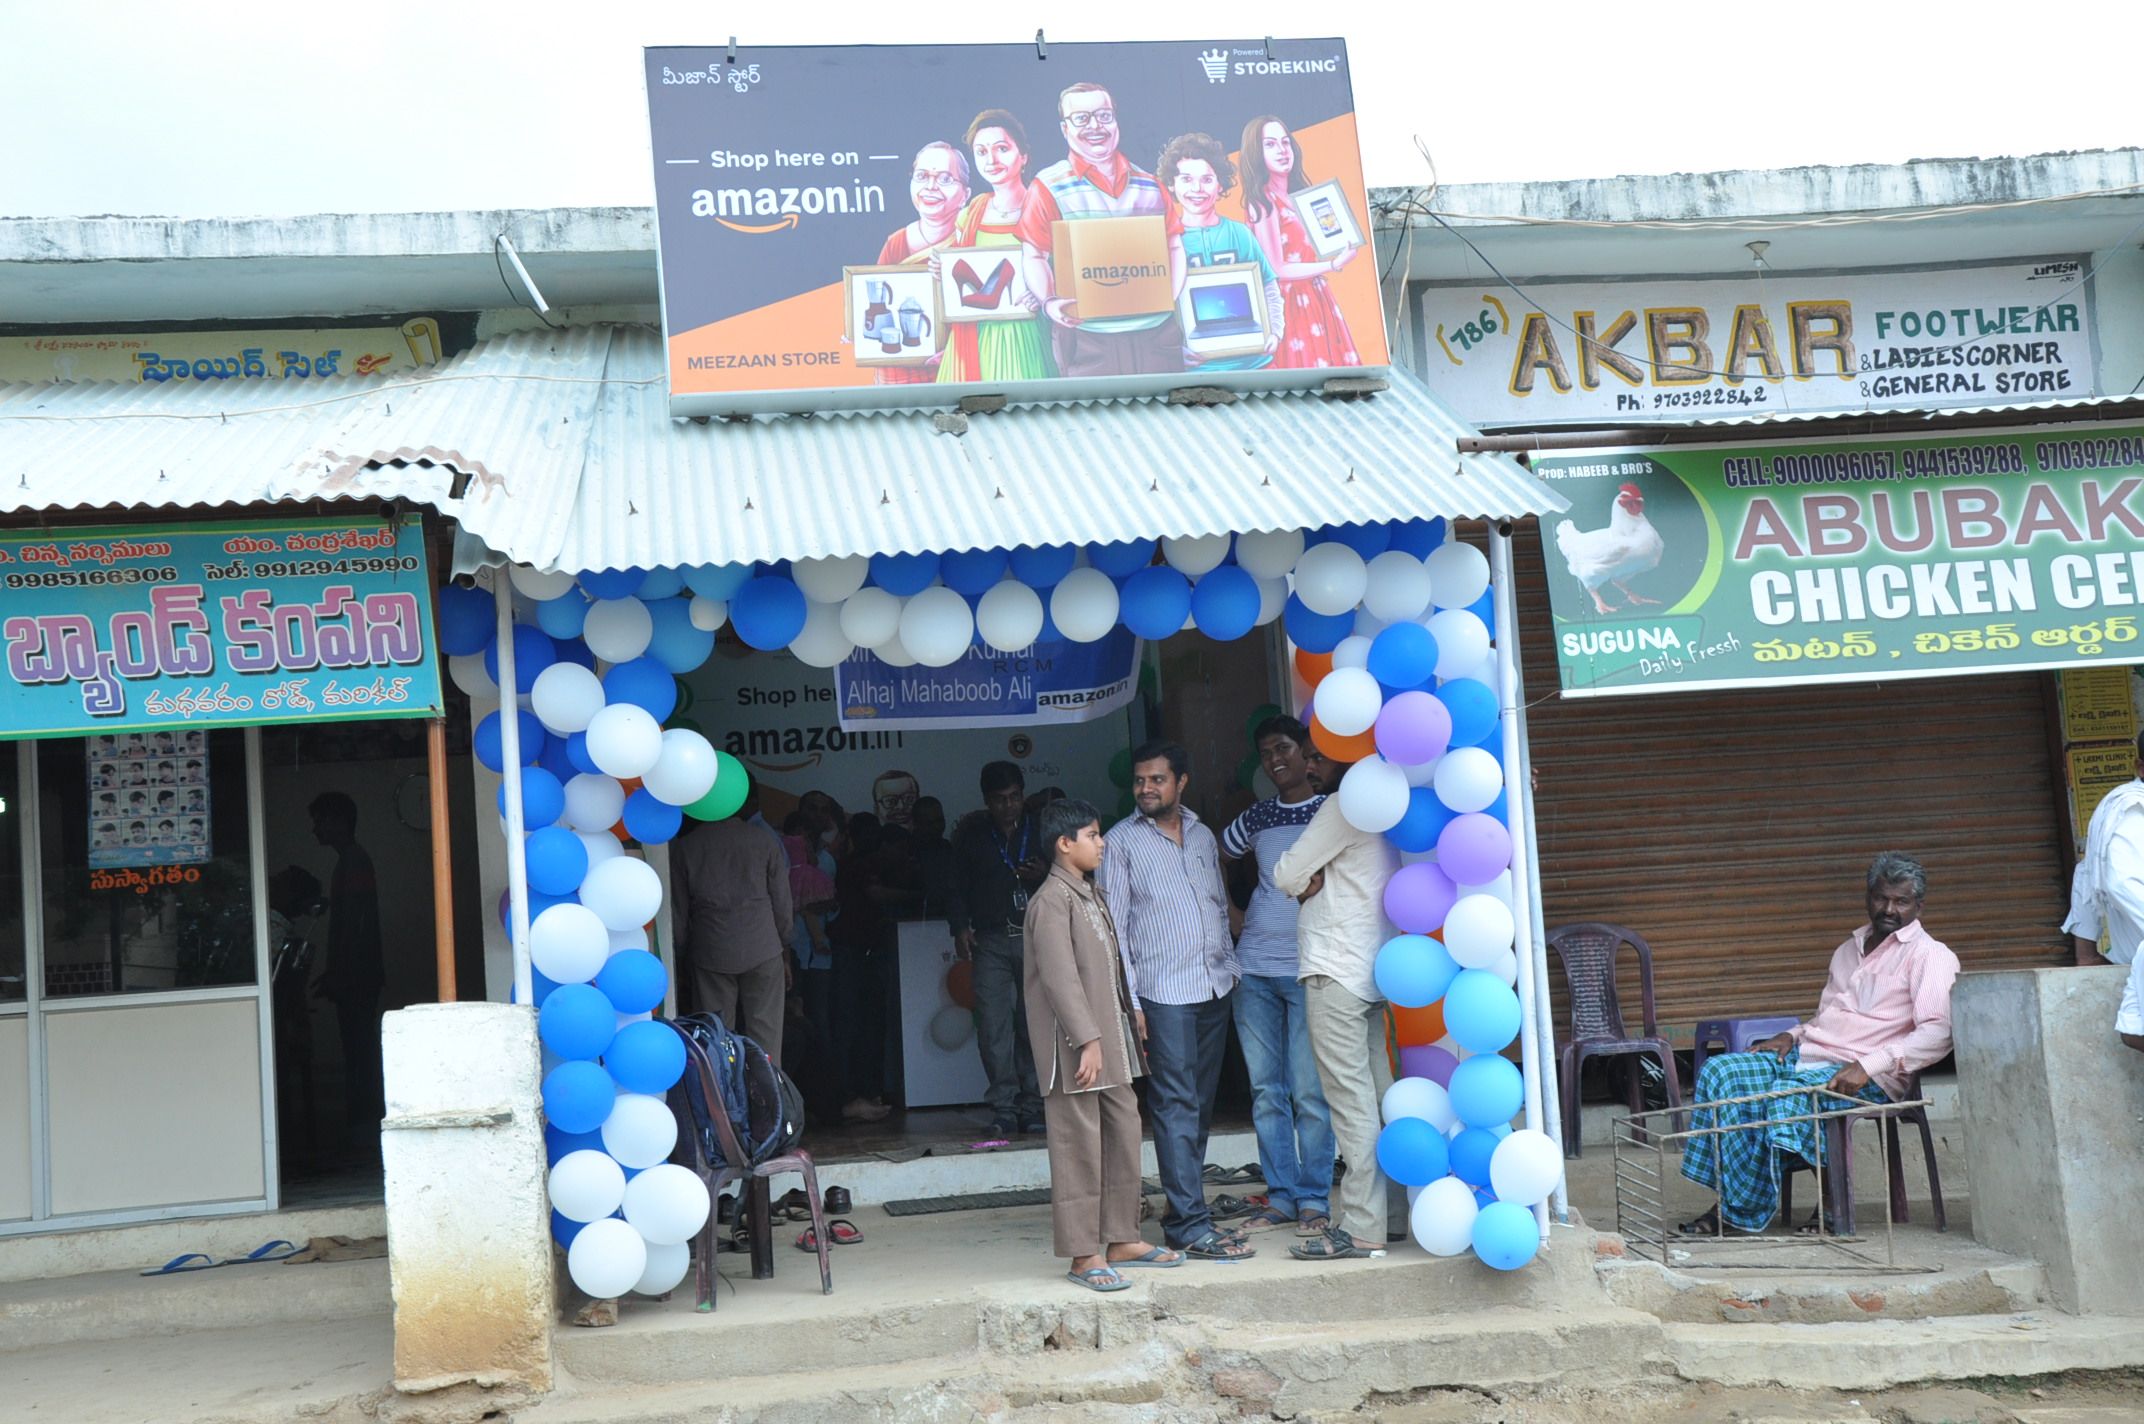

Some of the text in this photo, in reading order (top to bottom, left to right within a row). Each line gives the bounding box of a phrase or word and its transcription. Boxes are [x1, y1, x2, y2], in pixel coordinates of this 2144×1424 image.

[1232, 48, 1264, 57] Powered
[1234, 60, 1336, 75] STOREKING
[711, 150, 859, 171] Shop here on
[691, 178, 885, 217] amazon.in
[1081, 262, 1167, 280] amazon.in
[687, 351, 841, 370] MEEZAAN STORE
[1508, 300, 1859, 398] AKBAR
[1875, 304, 2080, 340] FOOTWEAR
[1872, 372, 1986, 398] GENERAL
[1996, 368, 2072, 395] STORE
[1653, 385, 1768, 410] 9703922842
[1537, 461, 1654, 481] Prop: HABEEB & BRO'S
[1723, 456, 1772, 489] CELL:
[1733, 477, 2144, 562] ABUBAK
[6, 566, 178, 589] 9985166306
[253, 555, 419, 578] 9912945990
[1749, 551, 2144, 627] CHICKEN CE
[1562, 626, 1681, 657] SUGUNA
[1751, 615, 2139, 664] మటన్ చికెన్ ఆర్డర్
[1639, 651, 1684, 677] Daily
[737, 686, 797, 708] Shop
[846, 675, 1033, 710] Alhaj Mahaboob Ali
[1038, 679, 1129, 707] amazon.in
